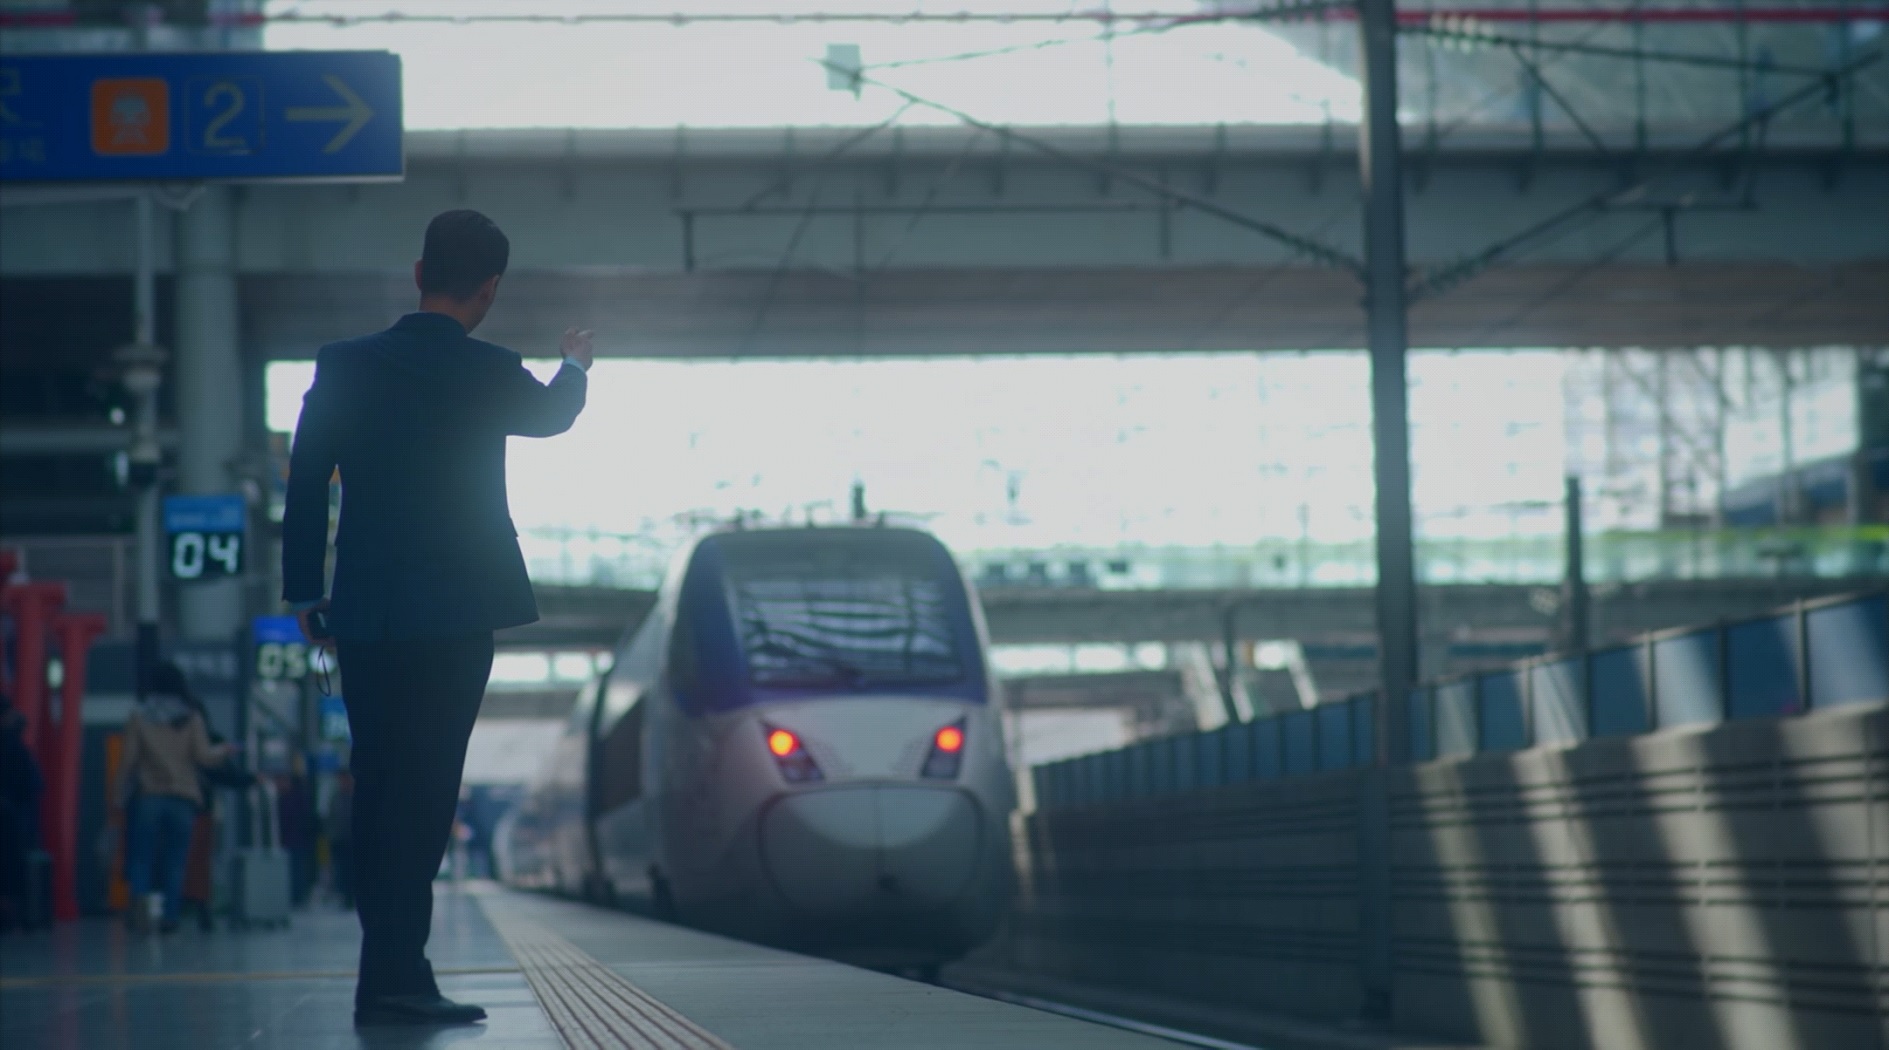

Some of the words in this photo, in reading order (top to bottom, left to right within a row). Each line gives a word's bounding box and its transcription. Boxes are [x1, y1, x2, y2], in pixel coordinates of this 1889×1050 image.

[204, 81, 246, 148] 2
[172, 532, 240, 579] 04
[257, 642, 307, 679] 05
